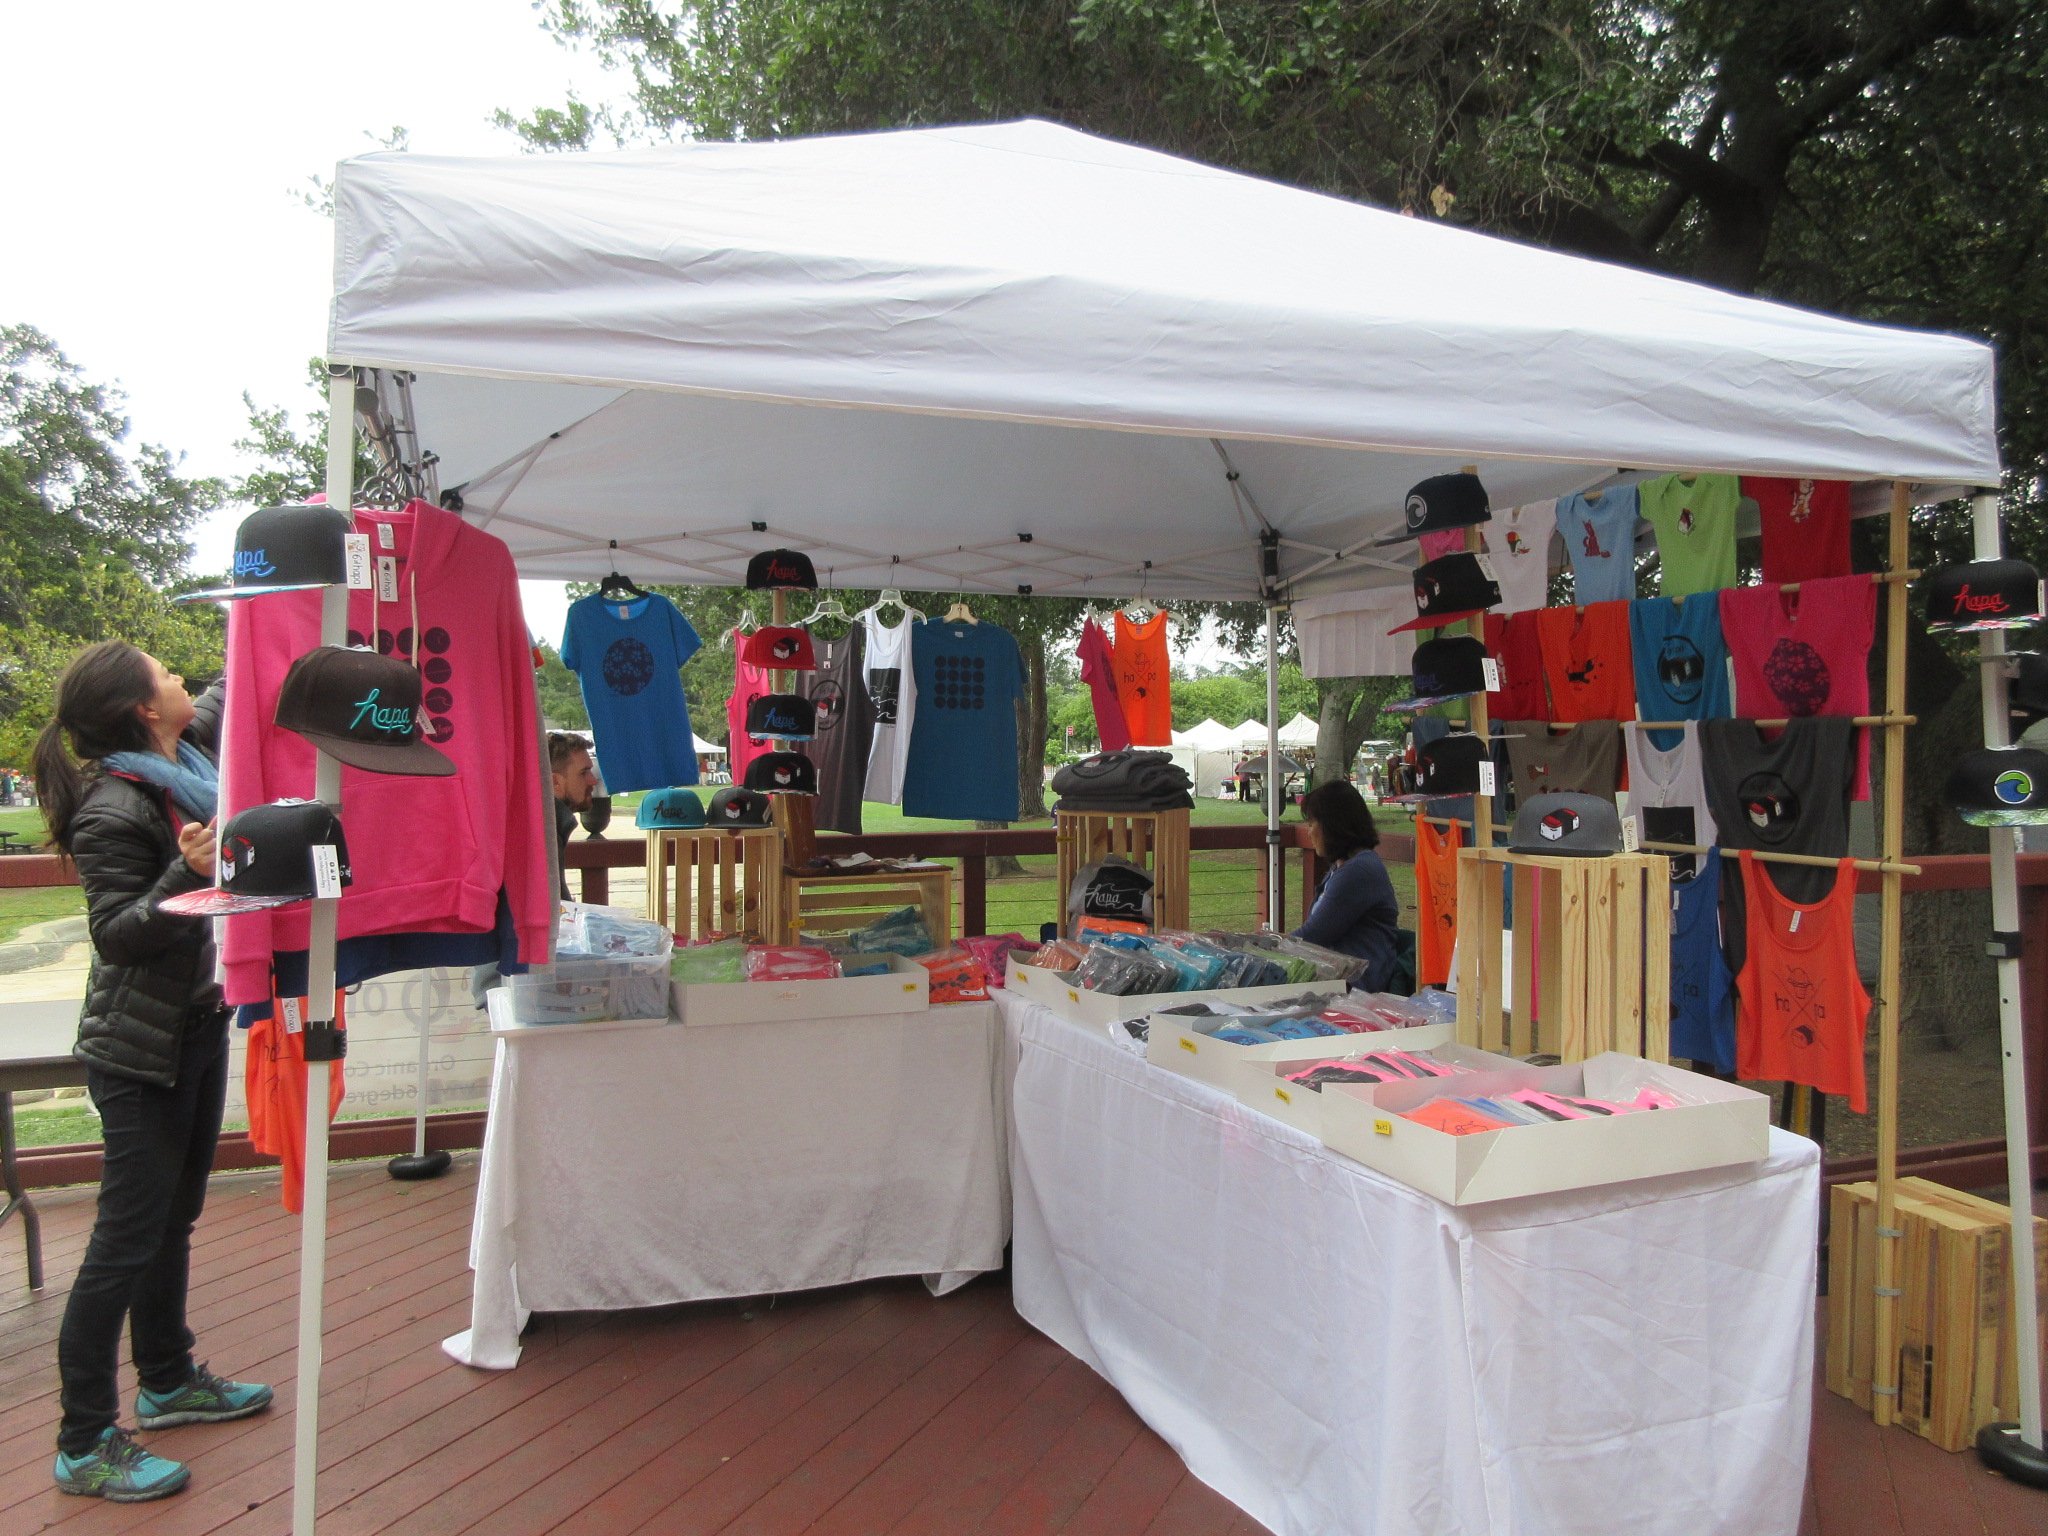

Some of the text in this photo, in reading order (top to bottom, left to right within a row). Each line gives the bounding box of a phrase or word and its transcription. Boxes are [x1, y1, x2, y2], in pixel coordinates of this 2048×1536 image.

[1952, 584, 2010, 615] hapa
[349, 687, 415, 735] hapa
[1085, 883, 1121, 908] hapa
